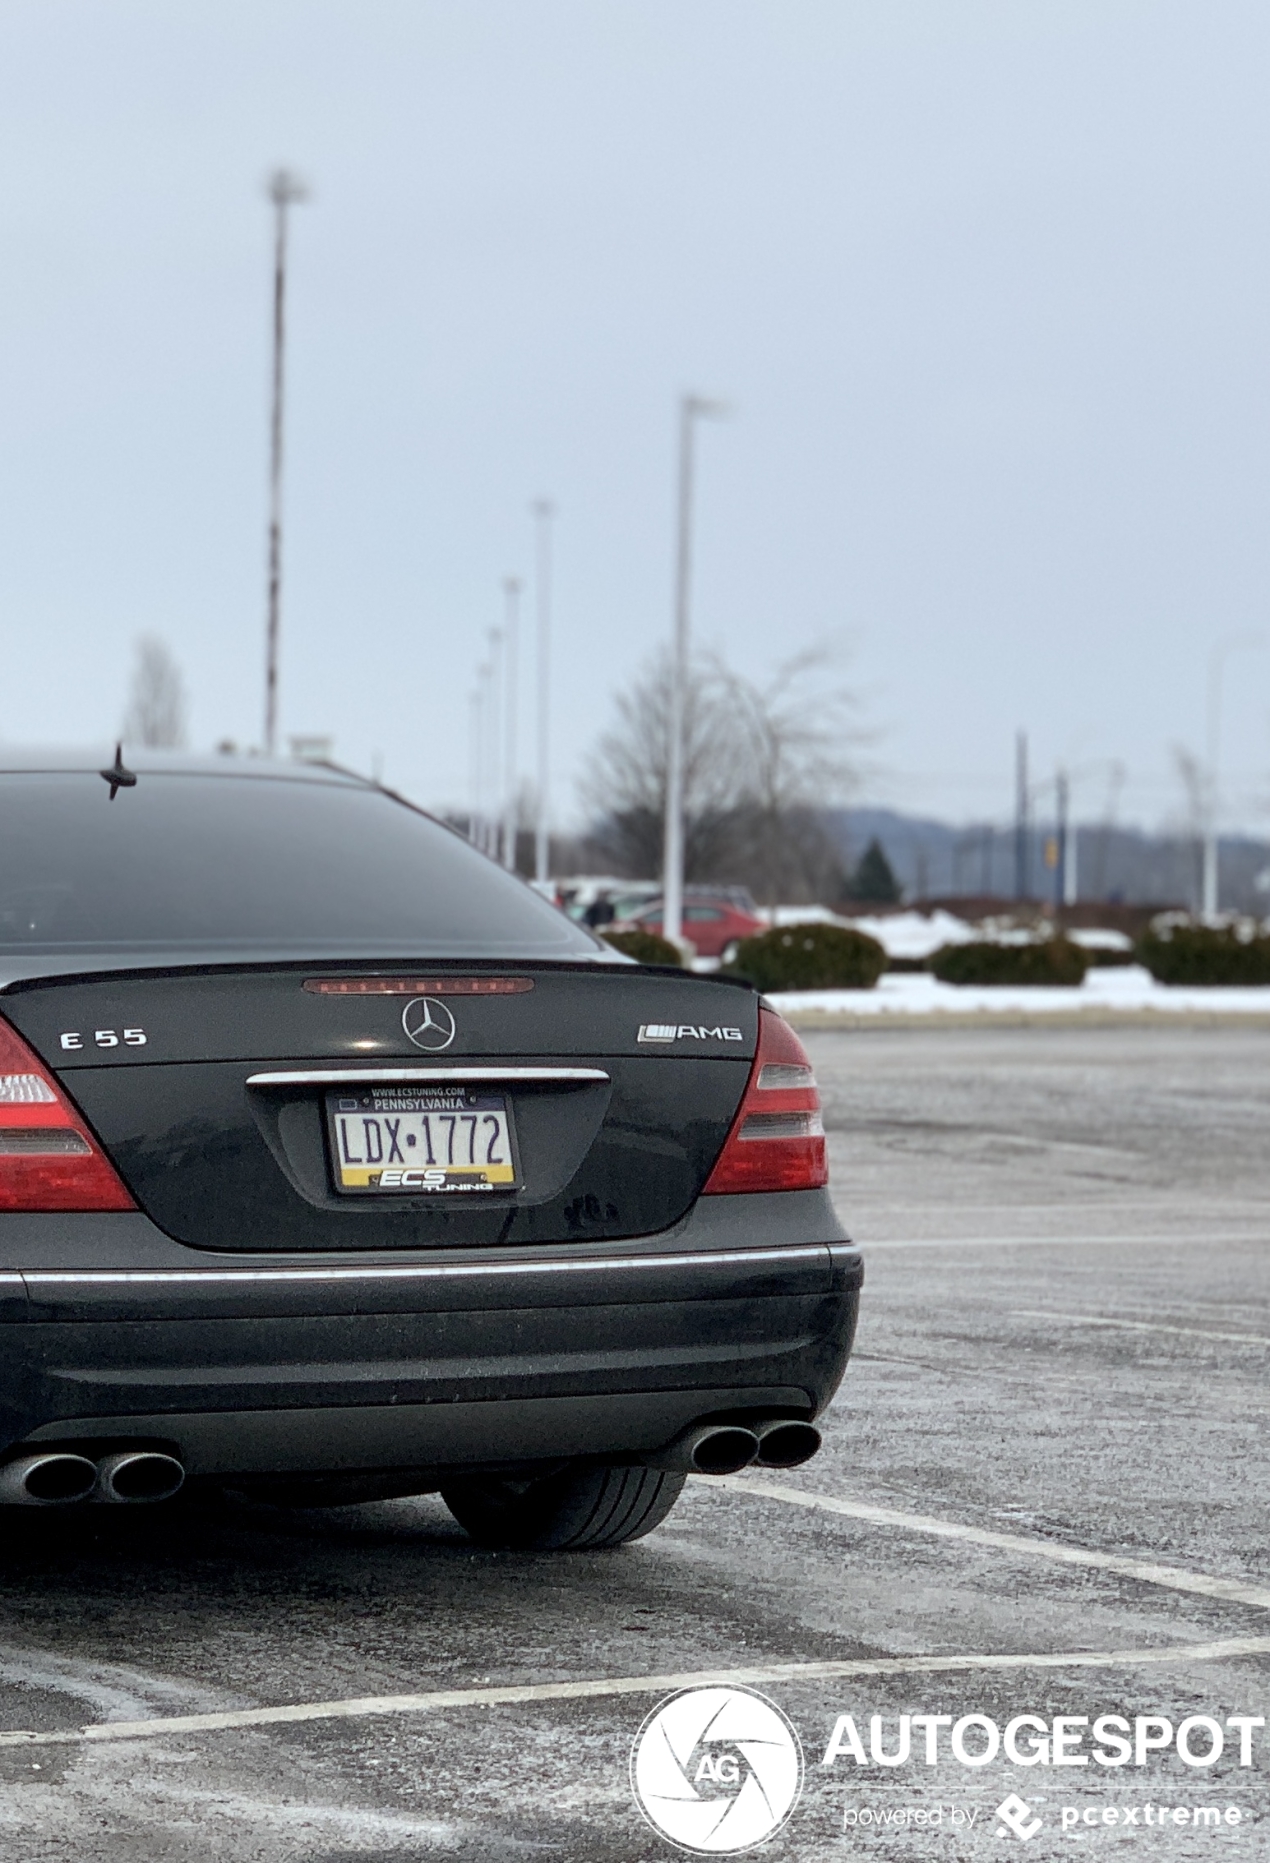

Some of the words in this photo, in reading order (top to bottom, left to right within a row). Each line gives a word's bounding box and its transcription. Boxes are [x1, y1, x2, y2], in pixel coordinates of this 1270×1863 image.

[60, 1032, 84, 1049] E
[94, 1028, 148, 1047] 55
[676, 1025, 743, 1041] AMG
[371, 1087, 466, 1098] WWW.ECSTUNING.COM
[374, 1098, 465, 1110] PENNSYLVANIA
[379, 1169, 447, 1186] ECS
[422, 1183, 494, 1191] TUNING
